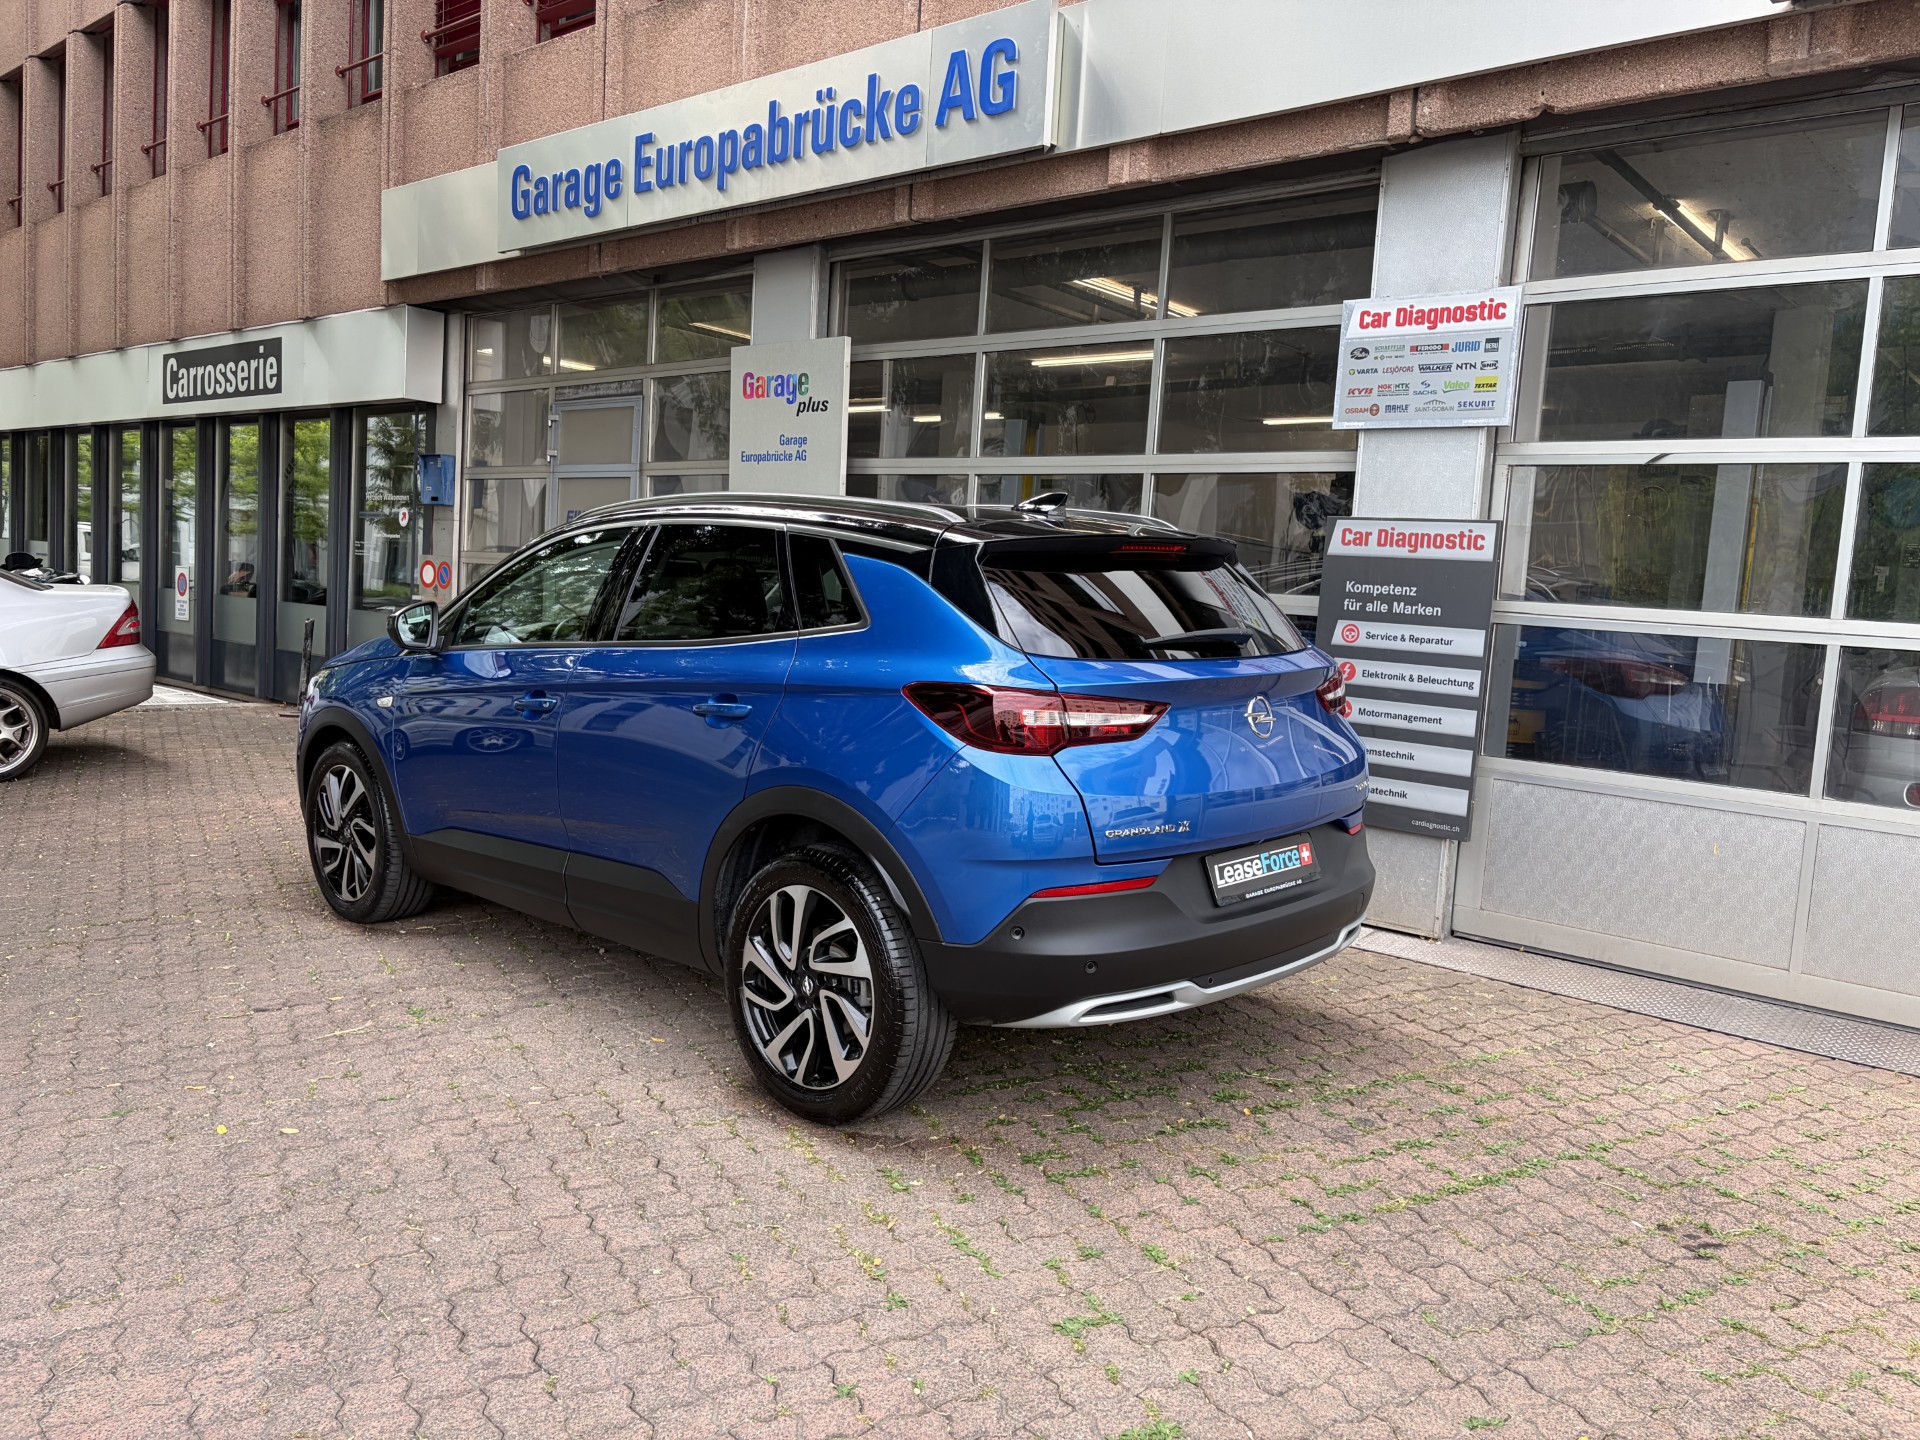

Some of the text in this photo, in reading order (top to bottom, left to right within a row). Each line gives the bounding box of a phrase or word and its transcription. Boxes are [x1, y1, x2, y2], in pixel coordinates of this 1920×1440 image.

[511, 38, 1019, 220] Garage Europabrücke AG
[1359, 298, 1507, 330] Car Diagnostic
[1451, 340, 1481, 353] JURID
[166, 345, 278, 399] Carrosserie
[1382, 366, 1414, 375] LESJÖFORS
[1418, 364, 1453, 373] WALKER
[1456, 362, 1477, 371] NTN
[743, 372, 809, 404] Garage
[1443, 380, 1470, 391] Valeo
[796, 397, 829, 417] plus
[1457, 400, 1496, 408] SEKURIT
[779, 434, 808, 448] Garage
[741, 449, 807, 464] Europabrücke AG
[1341, 527, 1486, 553] Car Diagnostic
[1345, 581, 1417, 596] Kompetenz
[1343, 599, 1442, 616] für alle Marken
[1365, 631, 1454, 646] Service & Reparatur
[1362, 670, 1475, 690] Elektronik & Beleuchtung
[1358, 707, 1442, 725] Motormanagement
[1368, 787, 1408, 800] atechnik
[1105, 820, 1191, 838] GRANDLAND X
[1411, 819, 1460, 833] cardiagnostic.ch
[1214, 850, 1300, 885] LeaseForce
[1245, 889, 1263, 899] GARAGE
[1264, 881, 1296, 894] EUROPABRÜCKE
